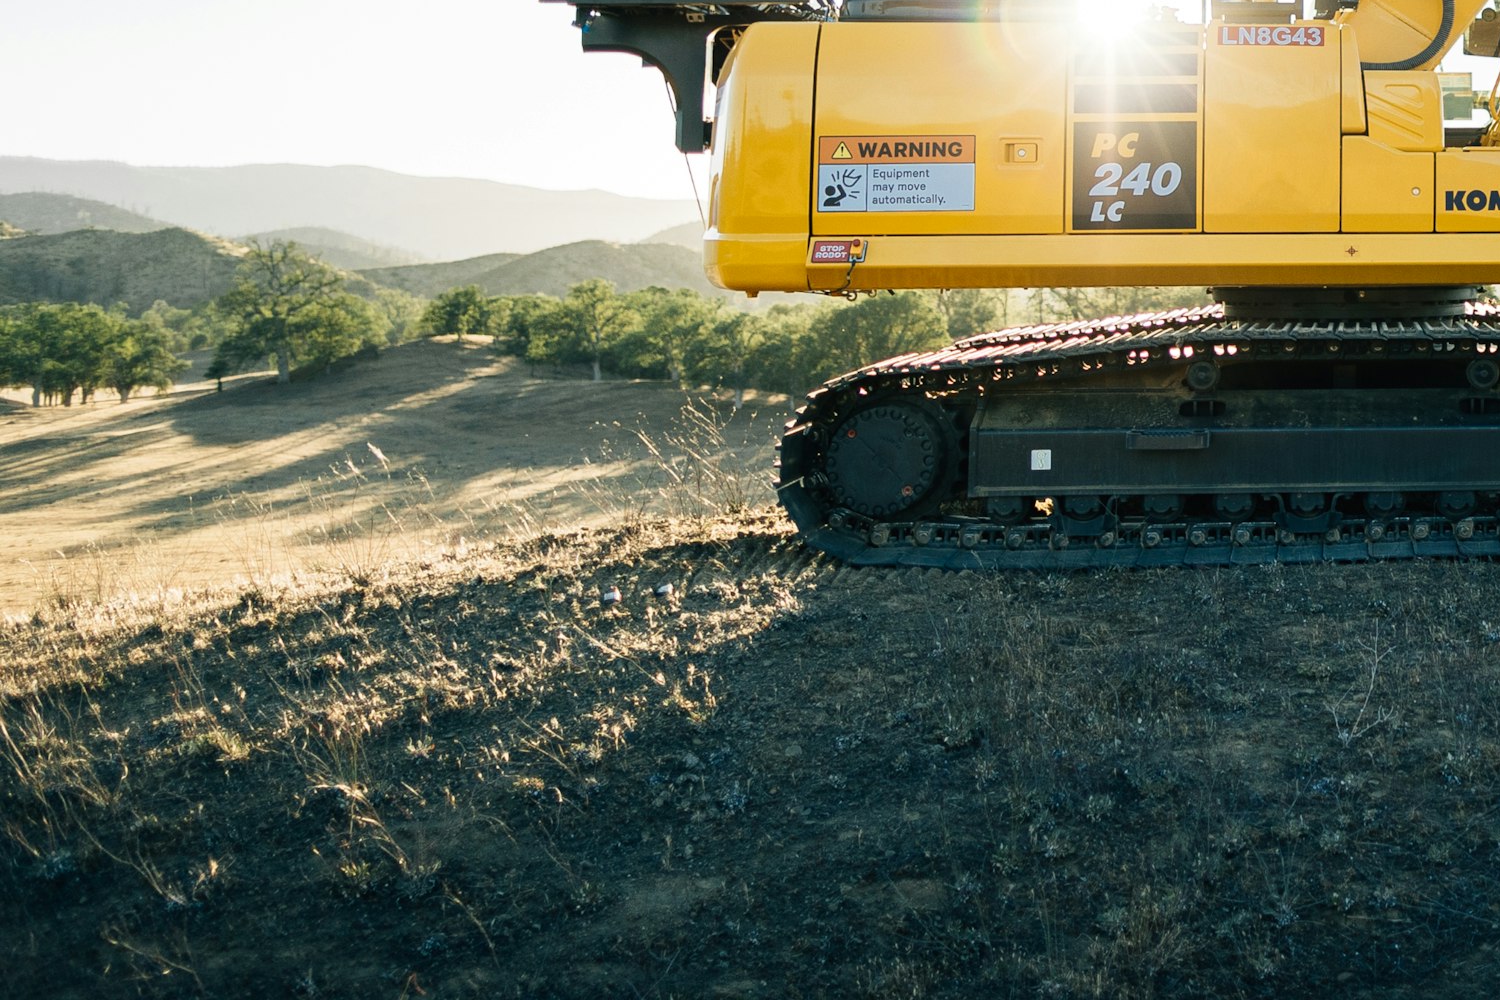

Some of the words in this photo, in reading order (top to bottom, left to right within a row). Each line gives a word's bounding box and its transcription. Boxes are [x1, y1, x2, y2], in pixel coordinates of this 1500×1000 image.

[1222, 26, 1322, 46] LN8G43
[858, 142, 963, 158] WARNING
[1091, 132, 1139, 158] PC
[872, 168, 930, 180] Equipment
[1089, 162, 1182, 196] 240
[872, 182, 895, 193] may
[898, 182, 926, 191] move
[872, 194, 946, 206] automatically.
[1090, 201, 1125, 222] LC
